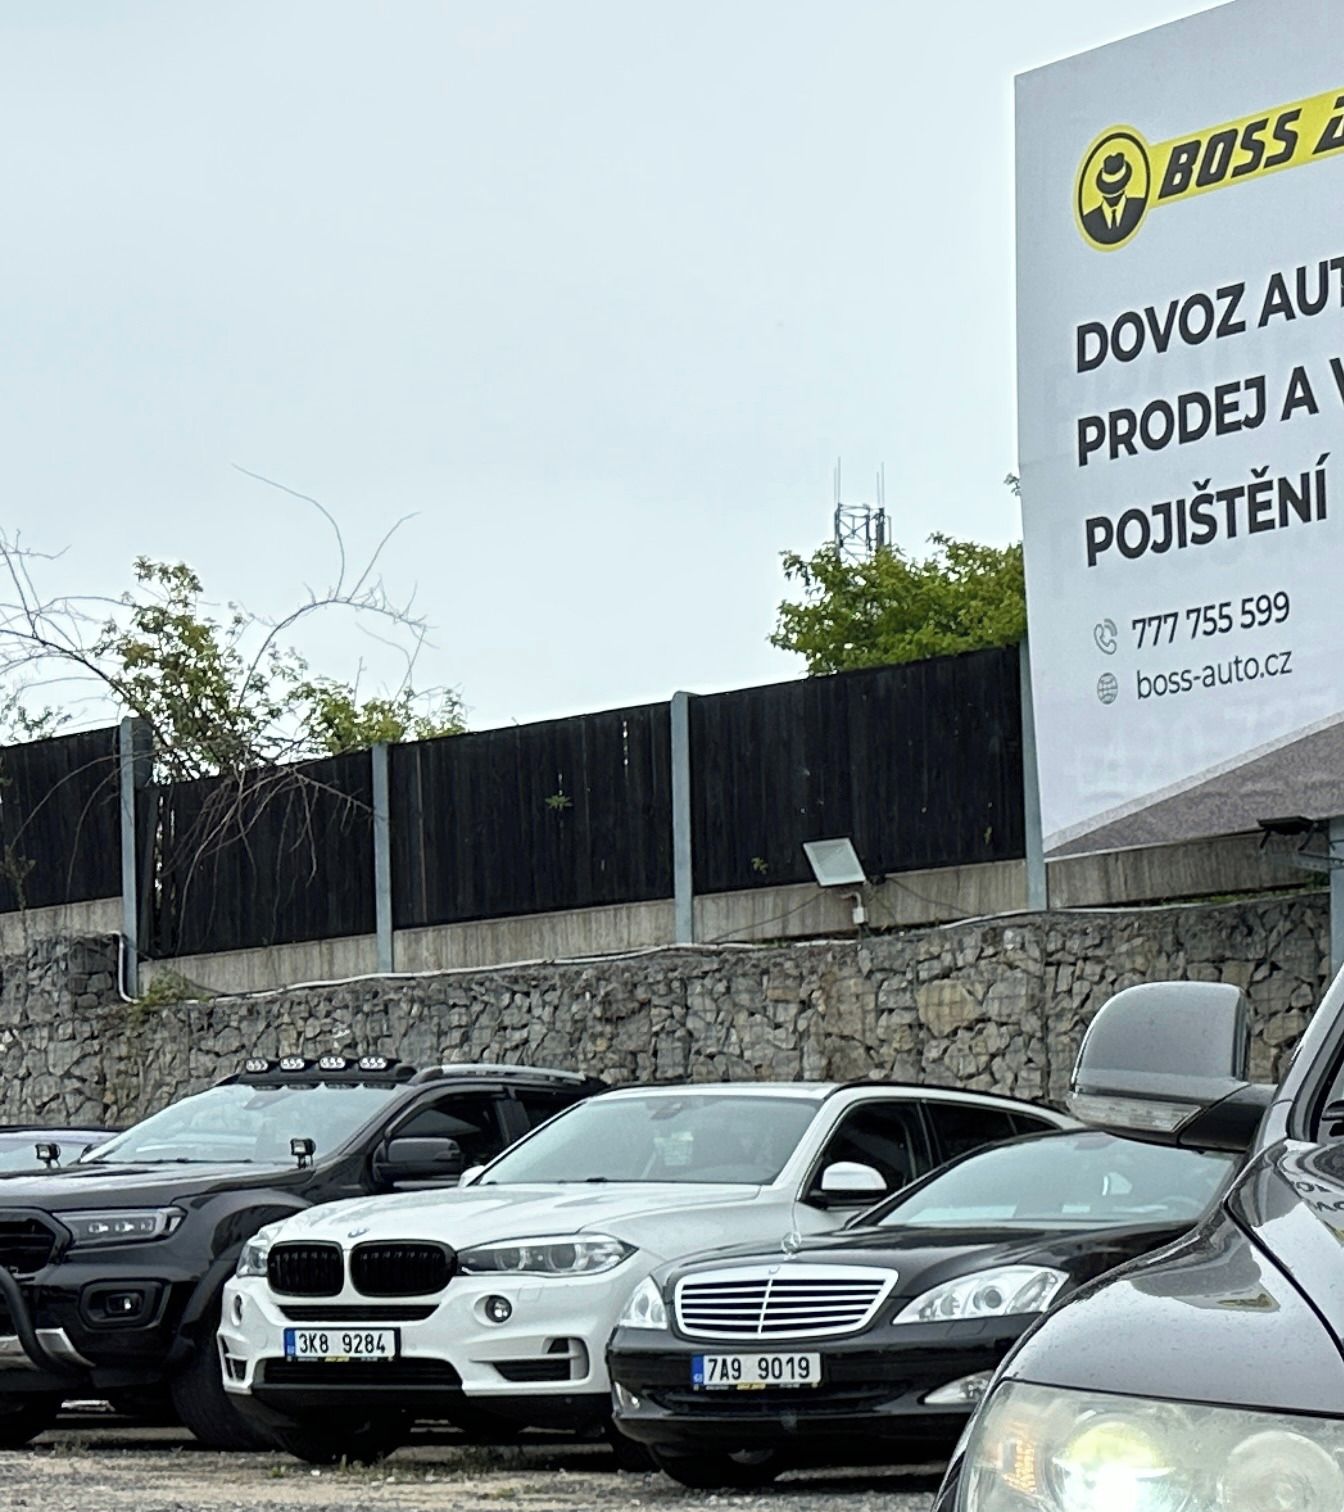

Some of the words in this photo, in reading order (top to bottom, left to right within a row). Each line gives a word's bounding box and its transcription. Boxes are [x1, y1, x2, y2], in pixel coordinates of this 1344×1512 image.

[1158, 109, 1303, 200] BOSS
[1076, 282, 1246, 372] DOVOZ
[1077, 375, 1265, 467] PRODEJ
[1280, 366, 1319, 421] A
[1085, 453, 1330, 567] POJIŠTĚNÍ
[1131, 611, 1180, 650] 777
[1187, 601, 1234, 640] 755
[1240, 591, 1290, 630] 599
[1136, 650, 1293, 700] boss-auto.cz
[299, 1333, 329, 1353] 3K8
[342, 1333, 386, 1353] 9284
[708, 1358, 742, 1381] 7A9
[758, 1357, 810, 1380] 9019
